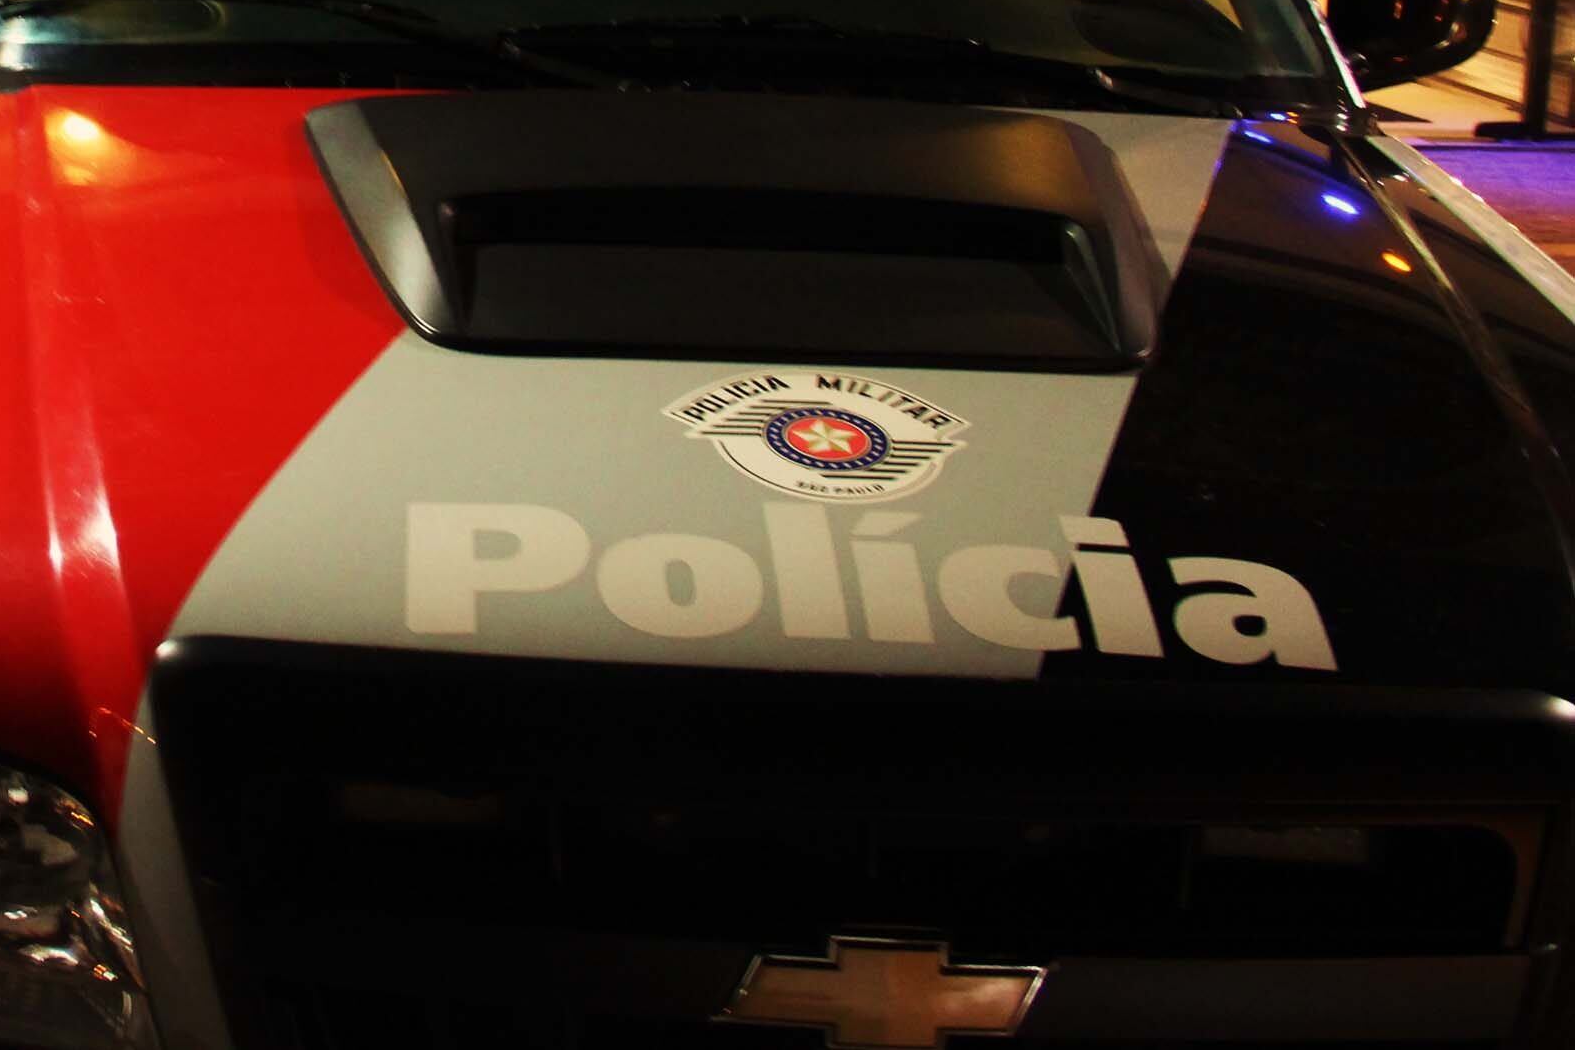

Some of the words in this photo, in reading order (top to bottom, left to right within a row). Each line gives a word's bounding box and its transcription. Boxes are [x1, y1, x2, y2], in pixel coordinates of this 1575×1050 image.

[683, 374, 792, 422] POLICIA
[816, 373, 953, 430] MILITAR
[405, 502, 1339, 672] Polícia
